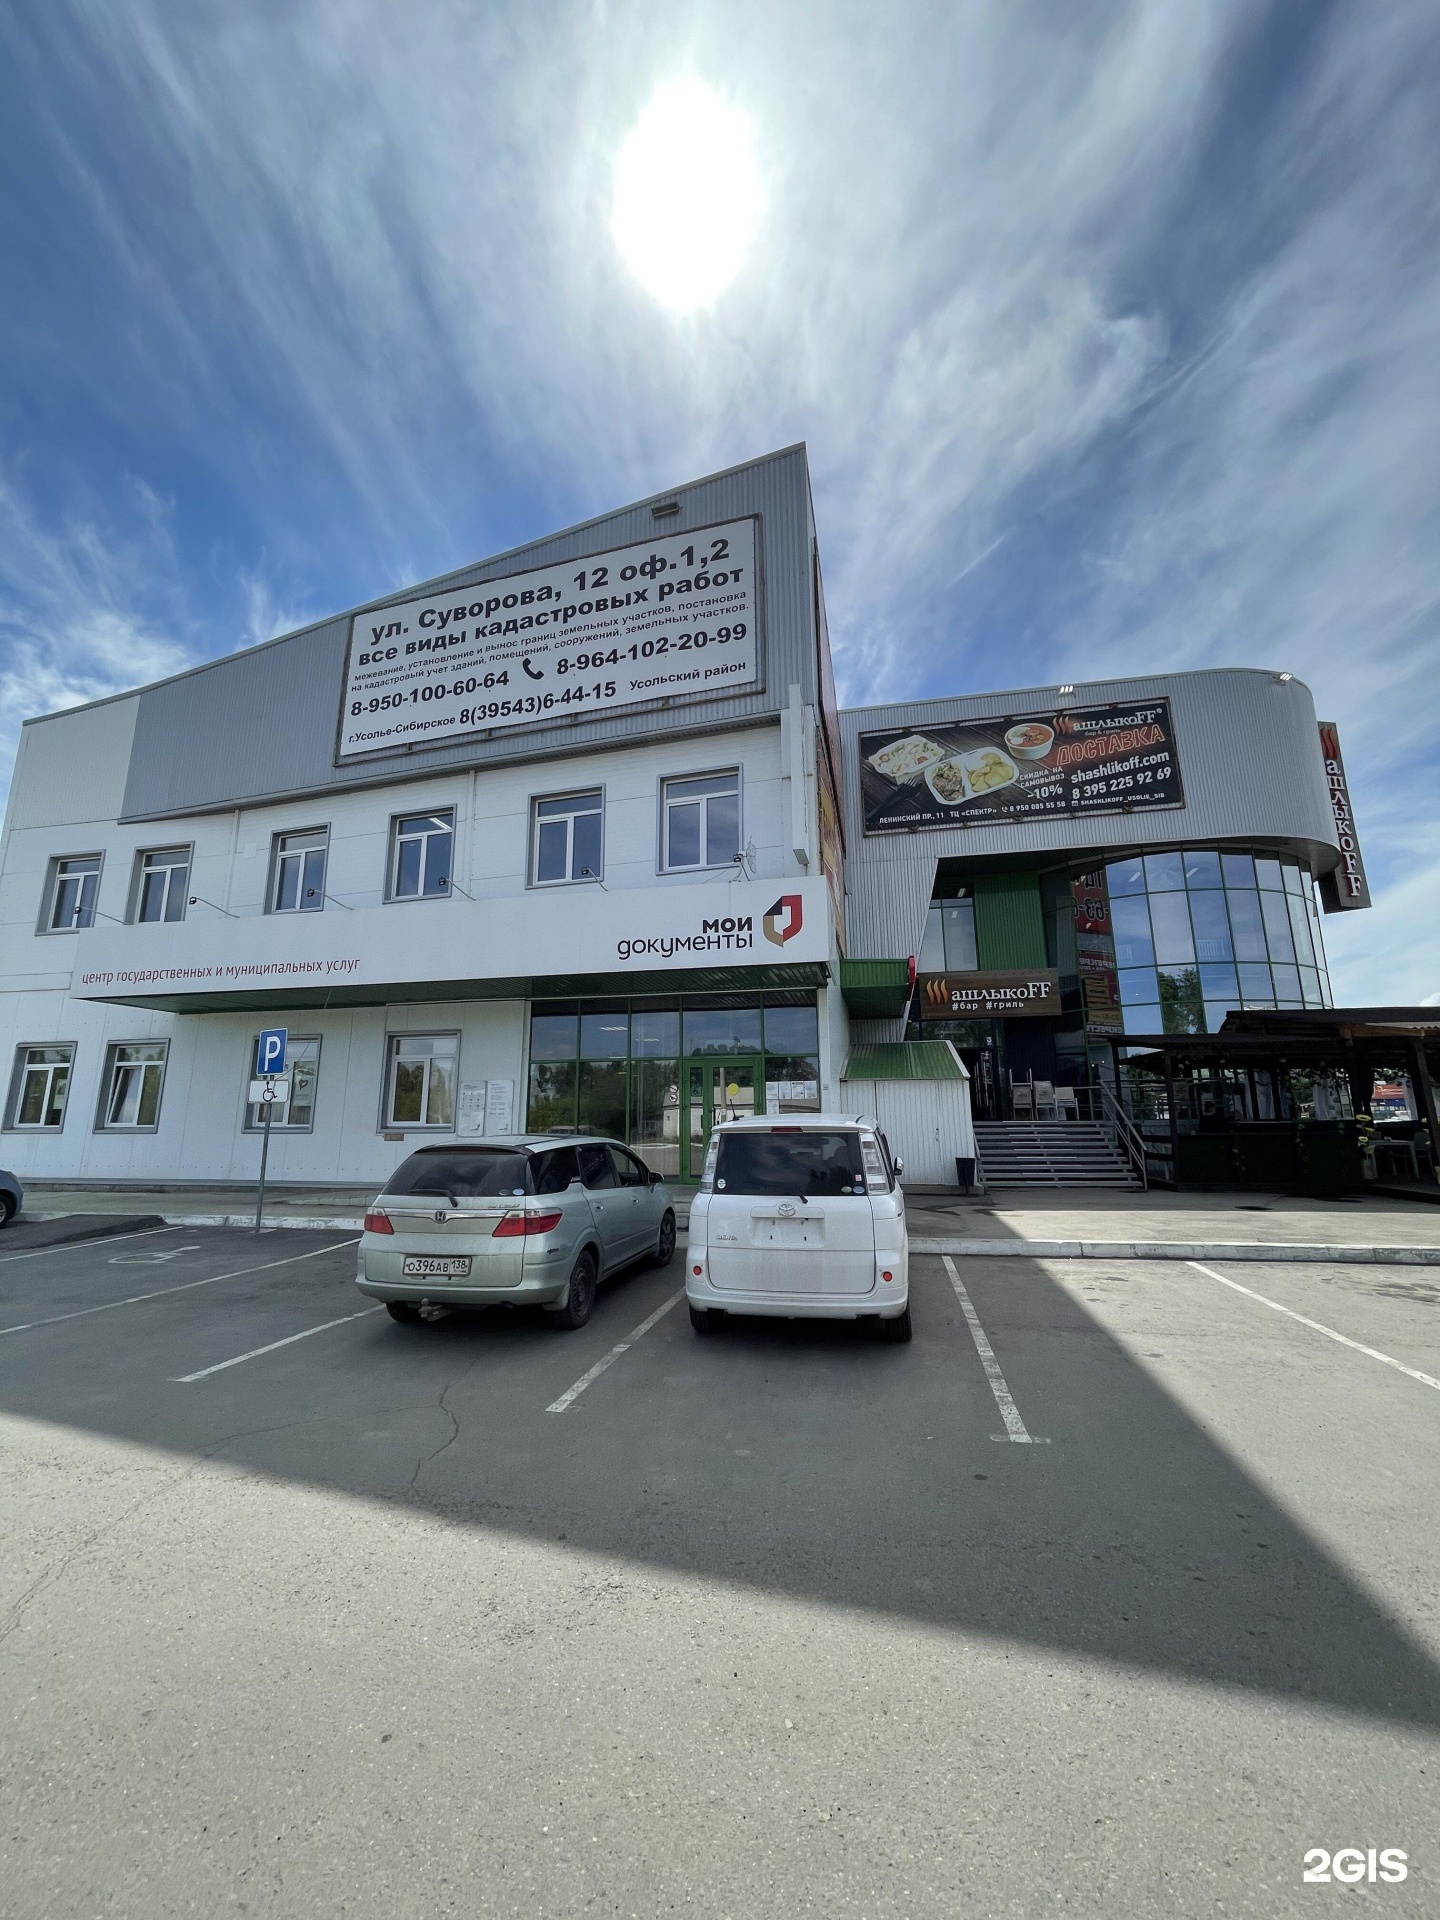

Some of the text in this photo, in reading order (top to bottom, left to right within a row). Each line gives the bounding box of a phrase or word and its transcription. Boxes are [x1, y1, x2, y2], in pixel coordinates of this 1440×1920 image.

[358, 568, 744, 666] все виды кадастровых работ
[370, 621, 409, 646] ул.
[418, 585, 562, 630] Суворова,
[573, 567, 609, 591] 12
[351, 603, 749, 692] на кадастровый учет зданий, помещений, сооружений, земельных участков.
[354, 591, 747, 681] межевание, установление и вынос границ земельных участков, постановка
[350, 623, 747, 717] 8-950-100-60-64 8-964-102-20-99
[349, 661, 746, 743] г.Усолье-Сибирское 8(39543)6-44-15 Усольский район
[1056, 724, 1166, 766] ДОСТАВКА
[1019, 766, 1063, 781] СКИДКА НА
[1020, 773, 1065, 788] САМОВЫВОЗ
[1070, 752, 1170, 784] shashlikoff.com
[1072, 766, 1172, 799] 8 395 225 92 69
[1027, 783, 1063, 799] -10%
[879, 813, 920, 824] ЛЕНИНСКИЙ
[961, 808, 997, 816] «СПЕКТР»
[1045, 801, 1055, 809] 55
[617, 933, 753, 961] документы
[82, 958, 361, 986] центр государственных и муниципальных услуг
[951, 1001, 1024, 1011] #бар #гриль
[264, 1035, 281, 1072] P
[451, 1259, 466, 1270] 138
